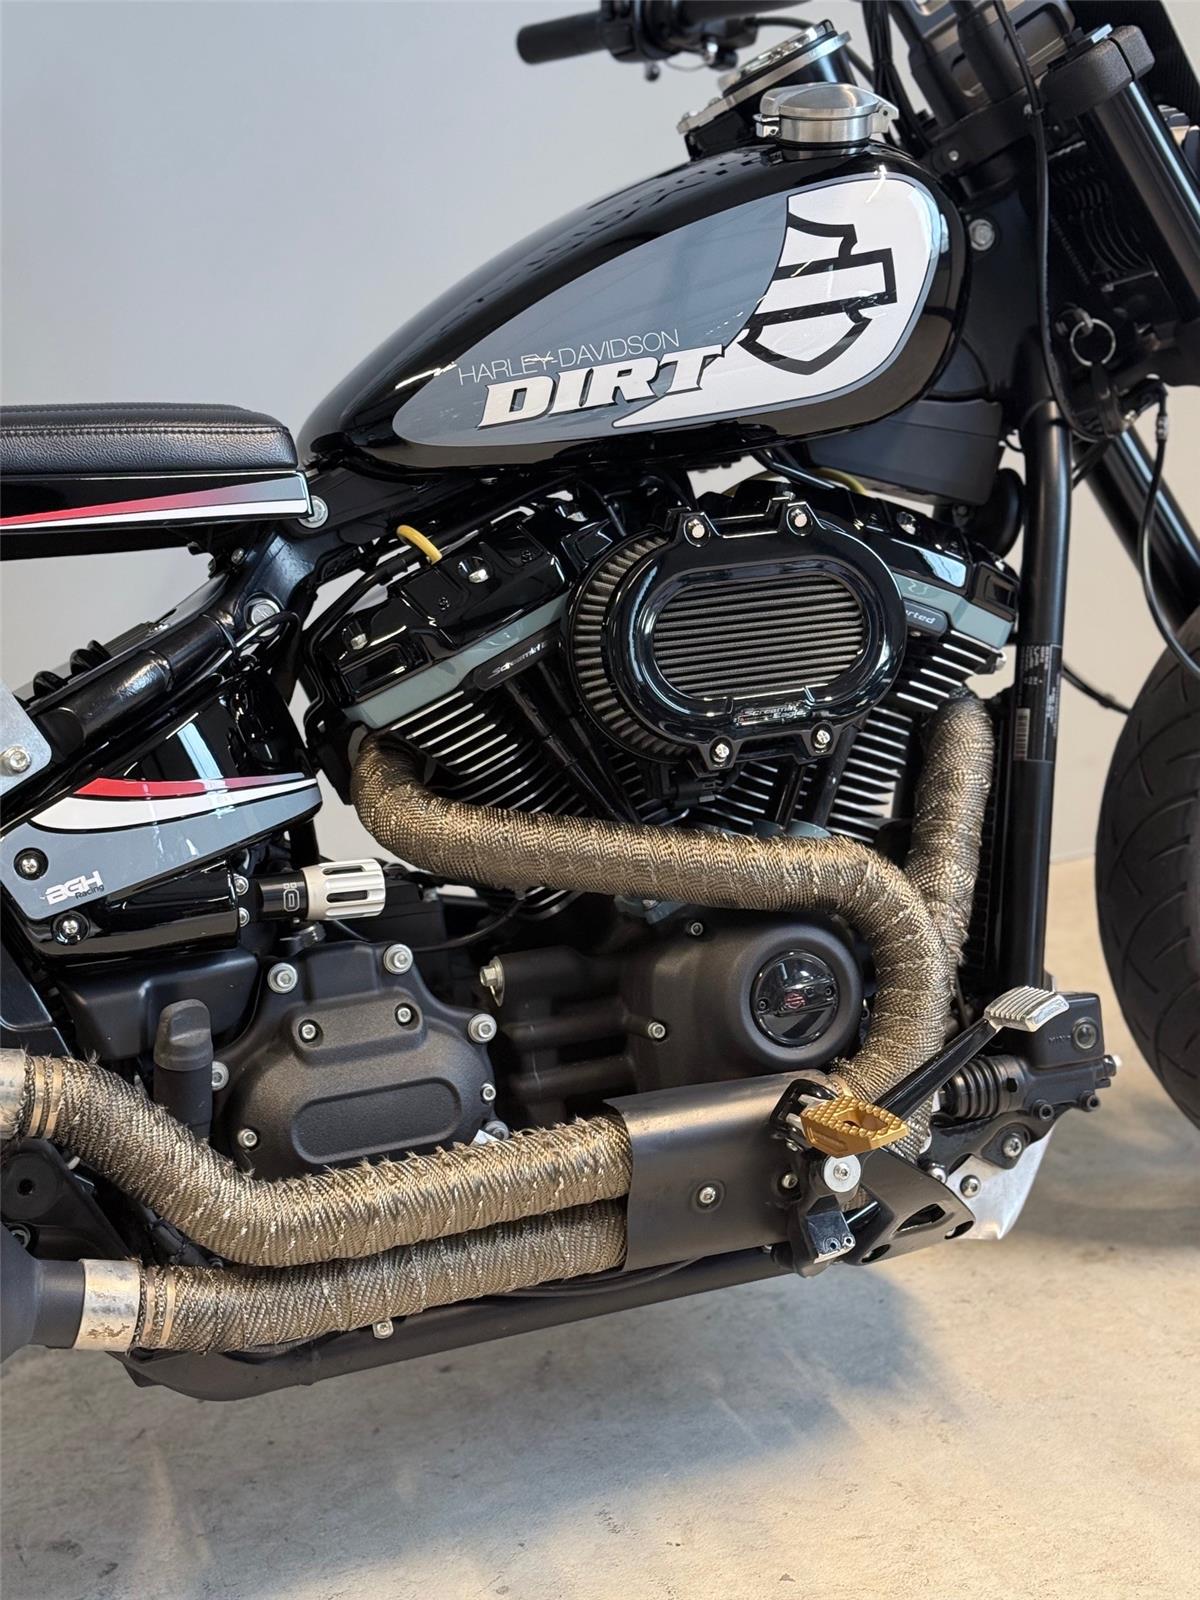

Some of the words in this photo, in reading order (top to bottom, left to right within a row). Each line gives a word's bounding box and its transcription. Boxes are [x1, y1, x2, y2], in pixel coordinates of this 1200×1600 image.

[458, 329, 680, 386] HARLEY-DAVIDSON
[476, 344, 723, 429] DIRT
[75, 884, 105, 899] Racing
